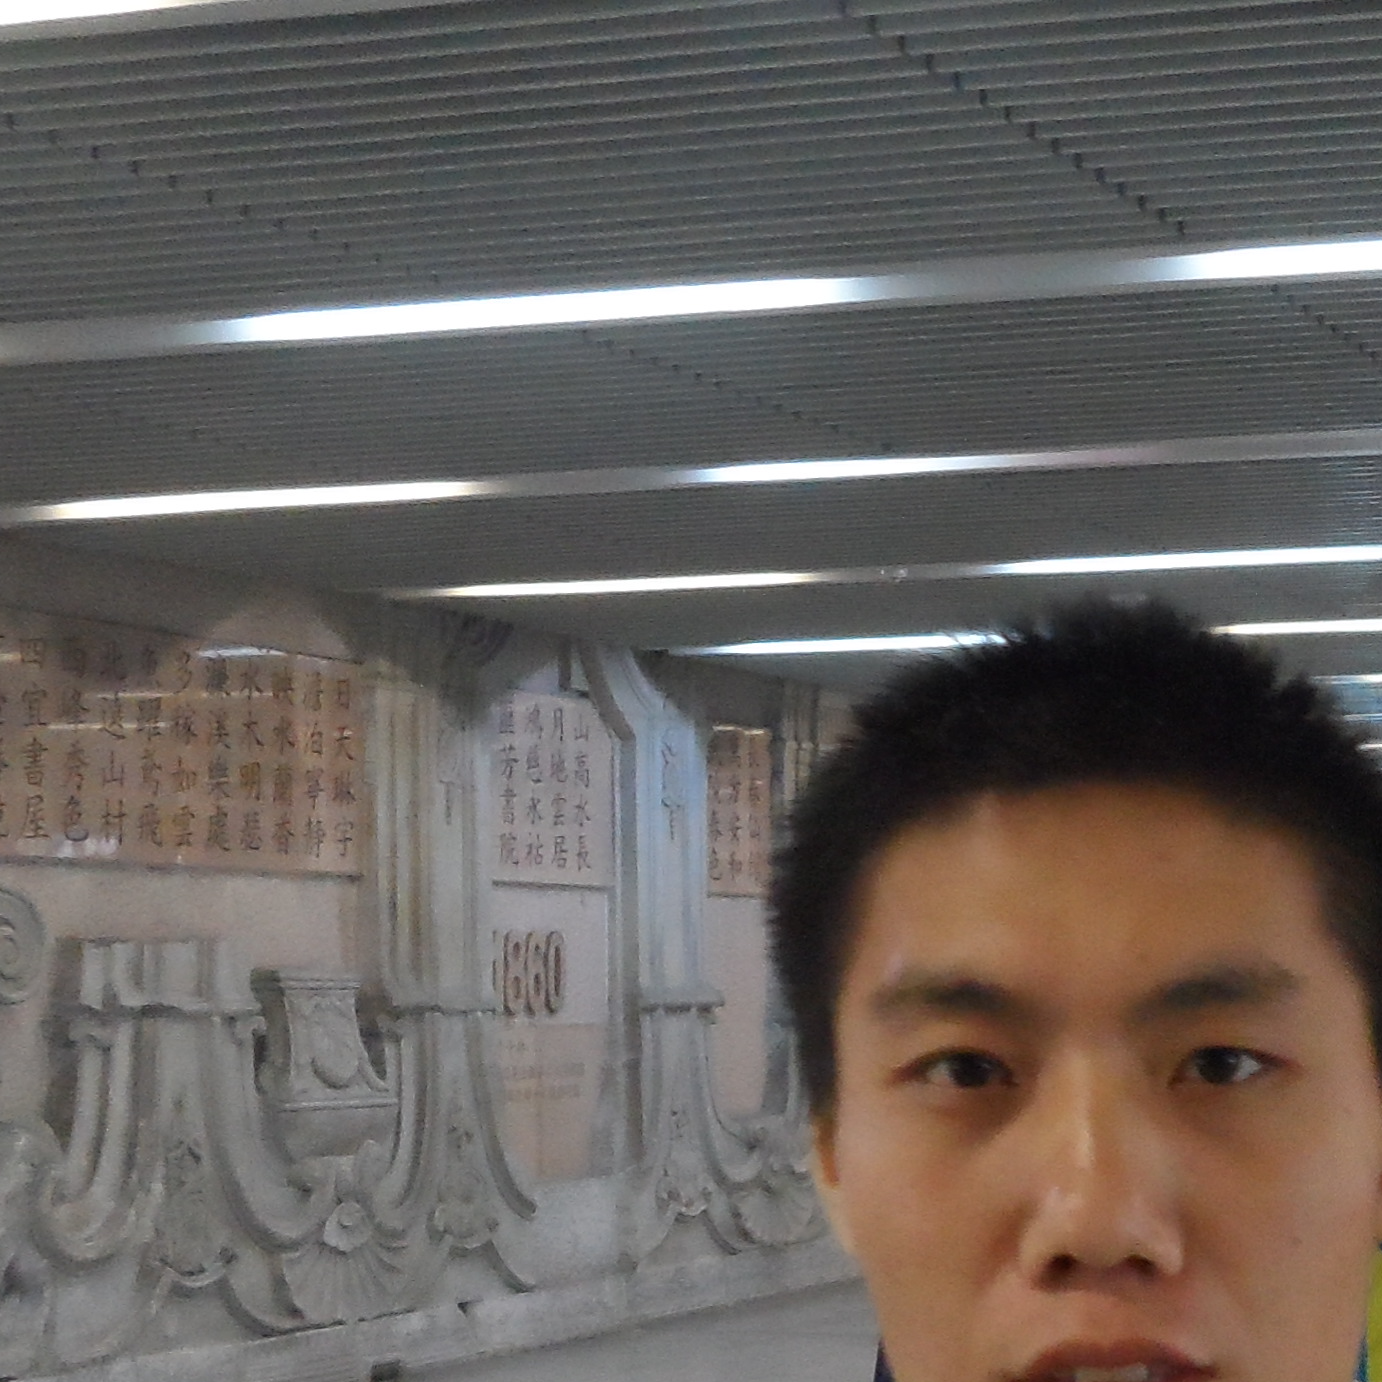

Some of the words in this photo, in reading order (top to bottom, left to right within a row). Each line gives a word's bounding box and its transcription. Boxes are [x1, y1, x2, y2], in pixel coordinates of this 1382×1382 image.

[18, 637, 50, 839] 四宜書屋
[332, 676, 357, 858] 日天琳宇
[550, 707, 568, 870] 月地雲居
[573, 713, 592, 872] 山高水長
